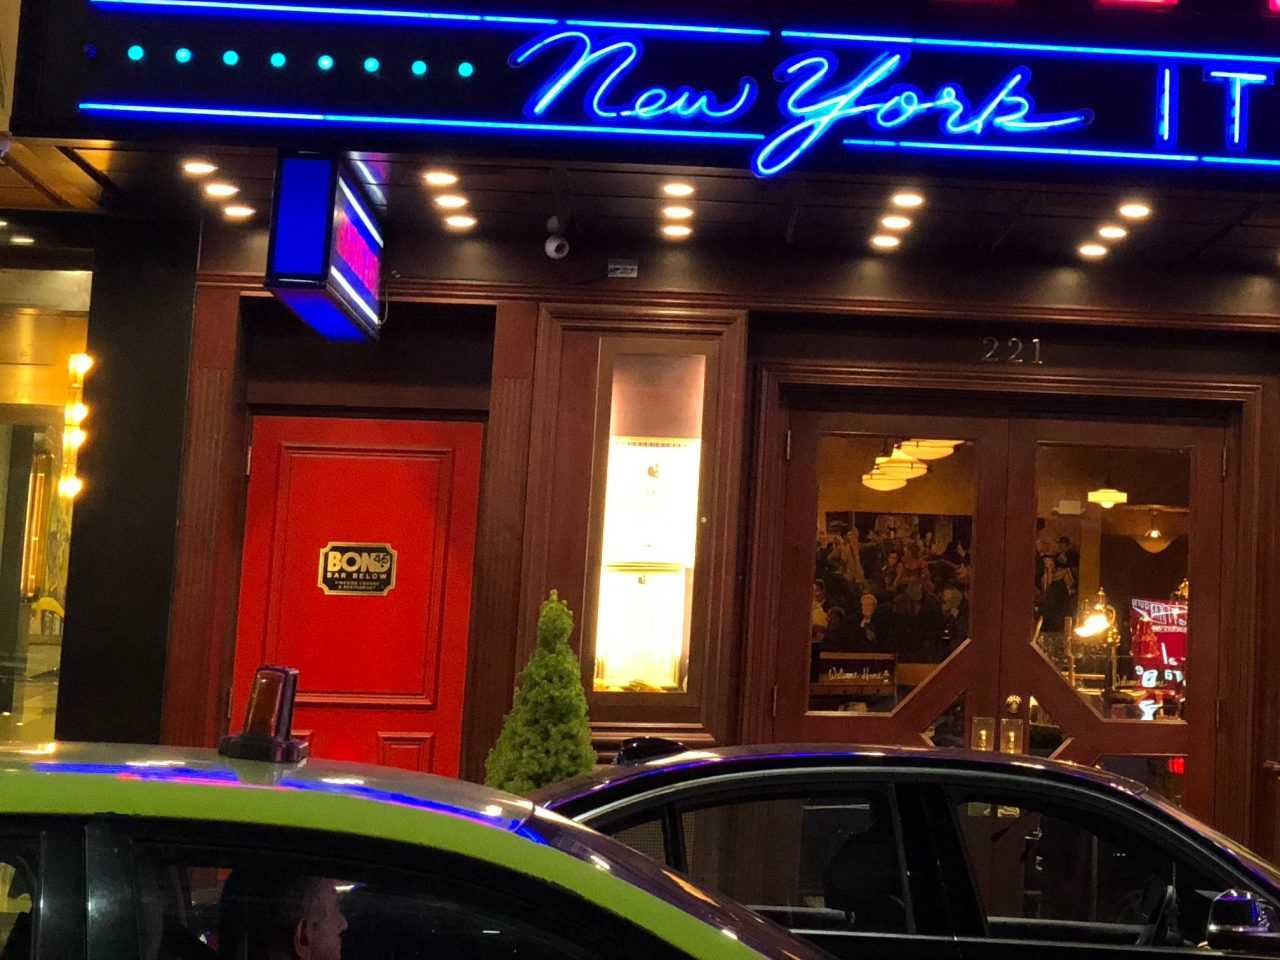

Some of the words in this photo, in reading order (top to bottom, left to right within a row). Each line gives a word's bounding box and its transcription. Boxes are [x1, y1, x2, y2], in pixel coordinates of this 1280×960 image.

[510, 29, 757, 119] New
[756, 47, 1092, 176] York
[981, 336, 1043, 364] 221
[327, 551, 391, 573] BOND
[352, 572, 388, 580] BELOW
